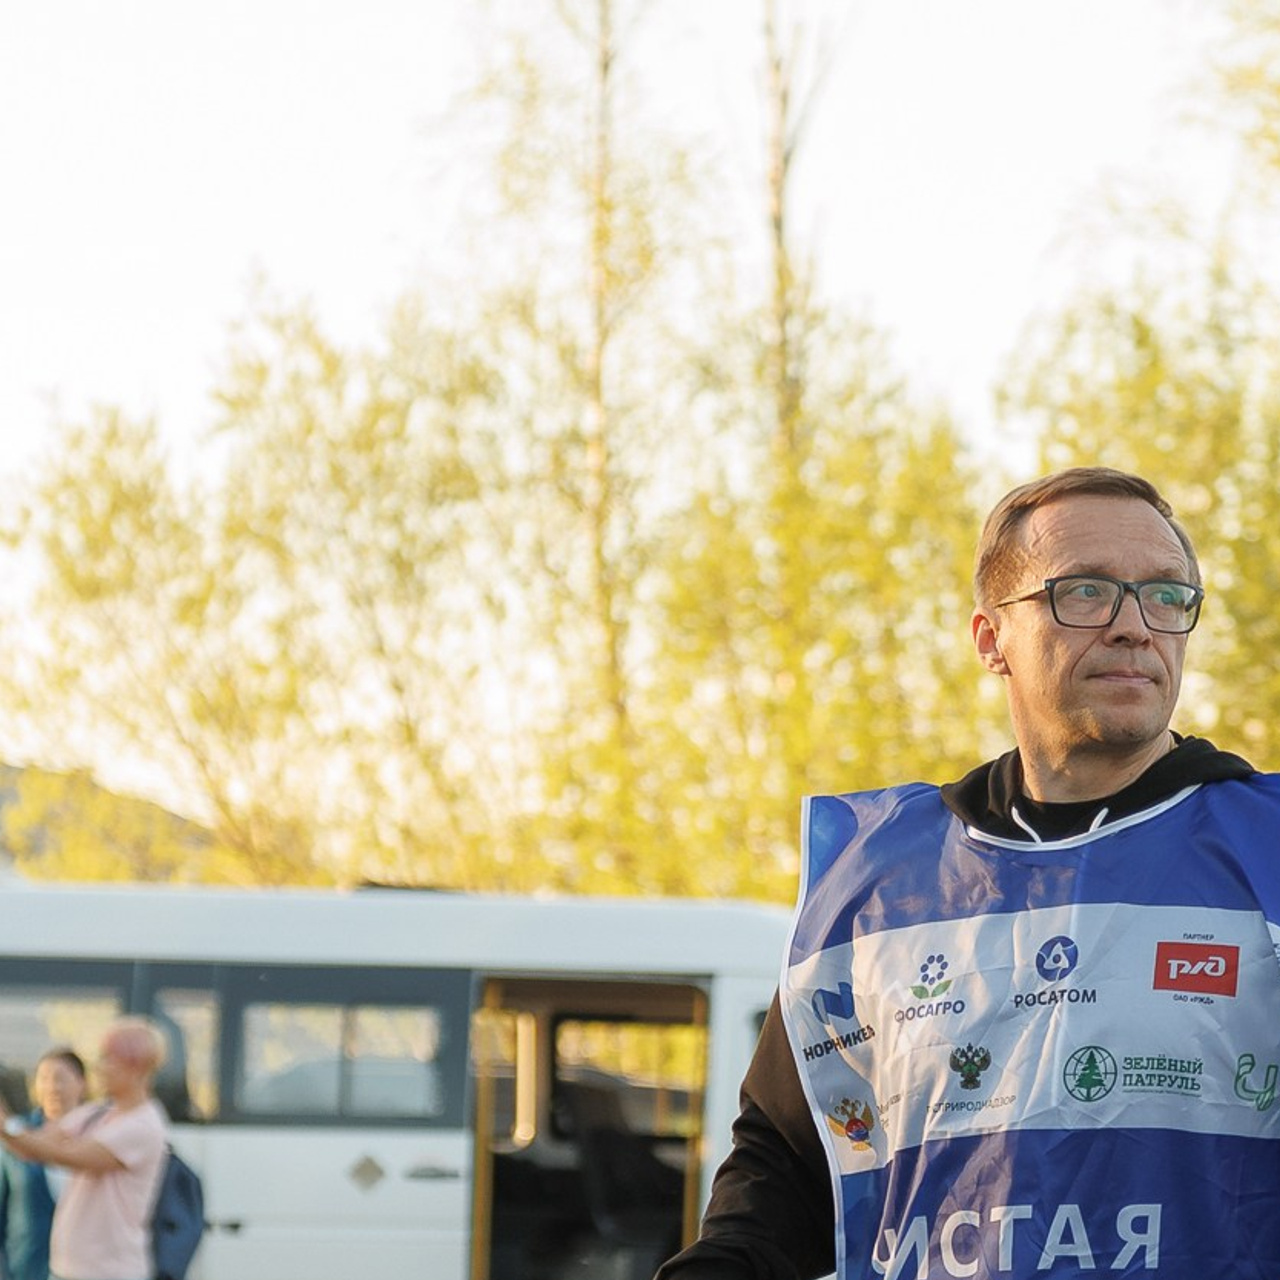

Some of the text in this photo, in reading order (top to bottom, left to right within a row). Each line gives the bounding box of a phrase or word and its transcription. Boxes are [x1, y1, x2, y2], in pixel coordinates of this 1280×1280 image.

[1013, 988, 1097, 1008] РОСАТОМ
[1122, 1053, 1204, 1075] ЗЕЛЁНЫЙ
[1122, 1073, 1202, 1091] ПАТРУЛЬ
